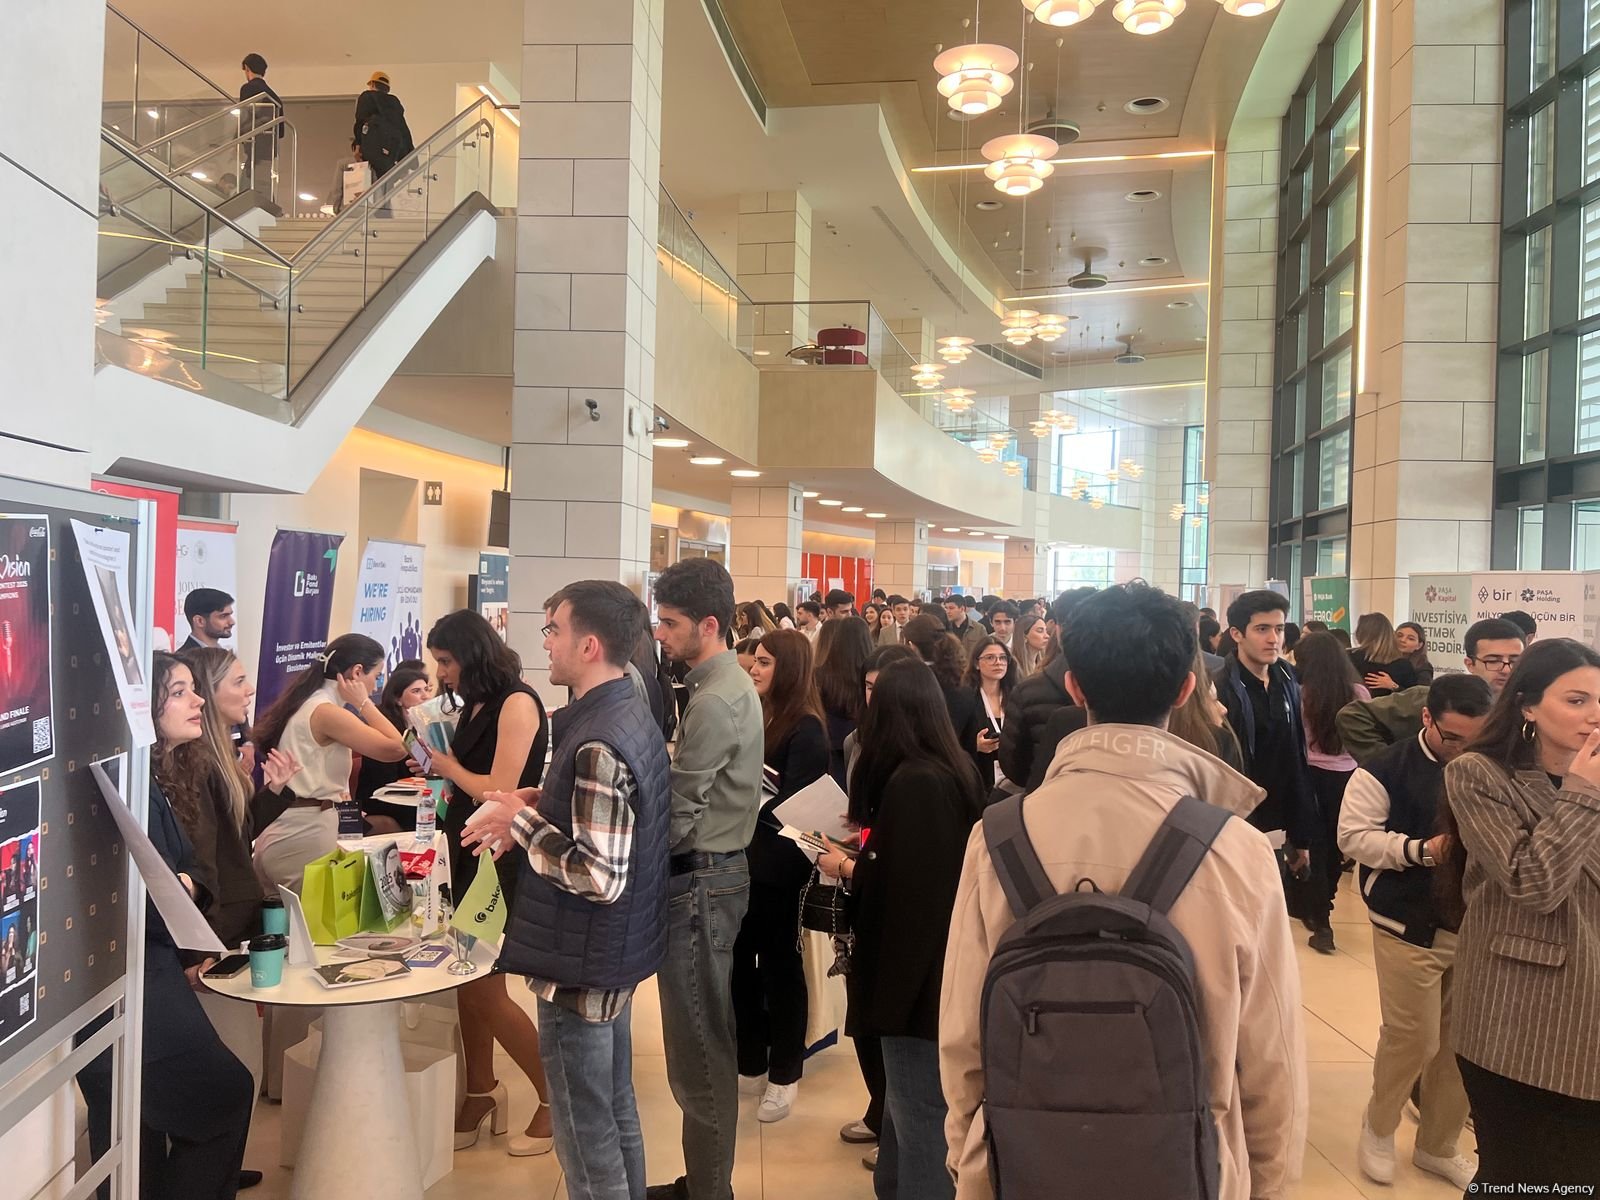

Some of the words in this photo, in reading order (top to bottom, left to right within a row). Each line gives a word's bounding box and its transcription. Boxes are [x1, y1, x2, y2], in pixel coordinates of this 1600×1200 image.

[364, 582, 389, 599] WE'RE
[1492, 588, 1512, 601] bir
[1536, 595, 1561, 603] Holding
[360, 606, 387, 623] HIRING
[1412, 609, 1468, 625] İNVESTİSİYA
[1477, 610, 1503, 619] MİLYO
[1559, 613, 1576, 622] BİR
